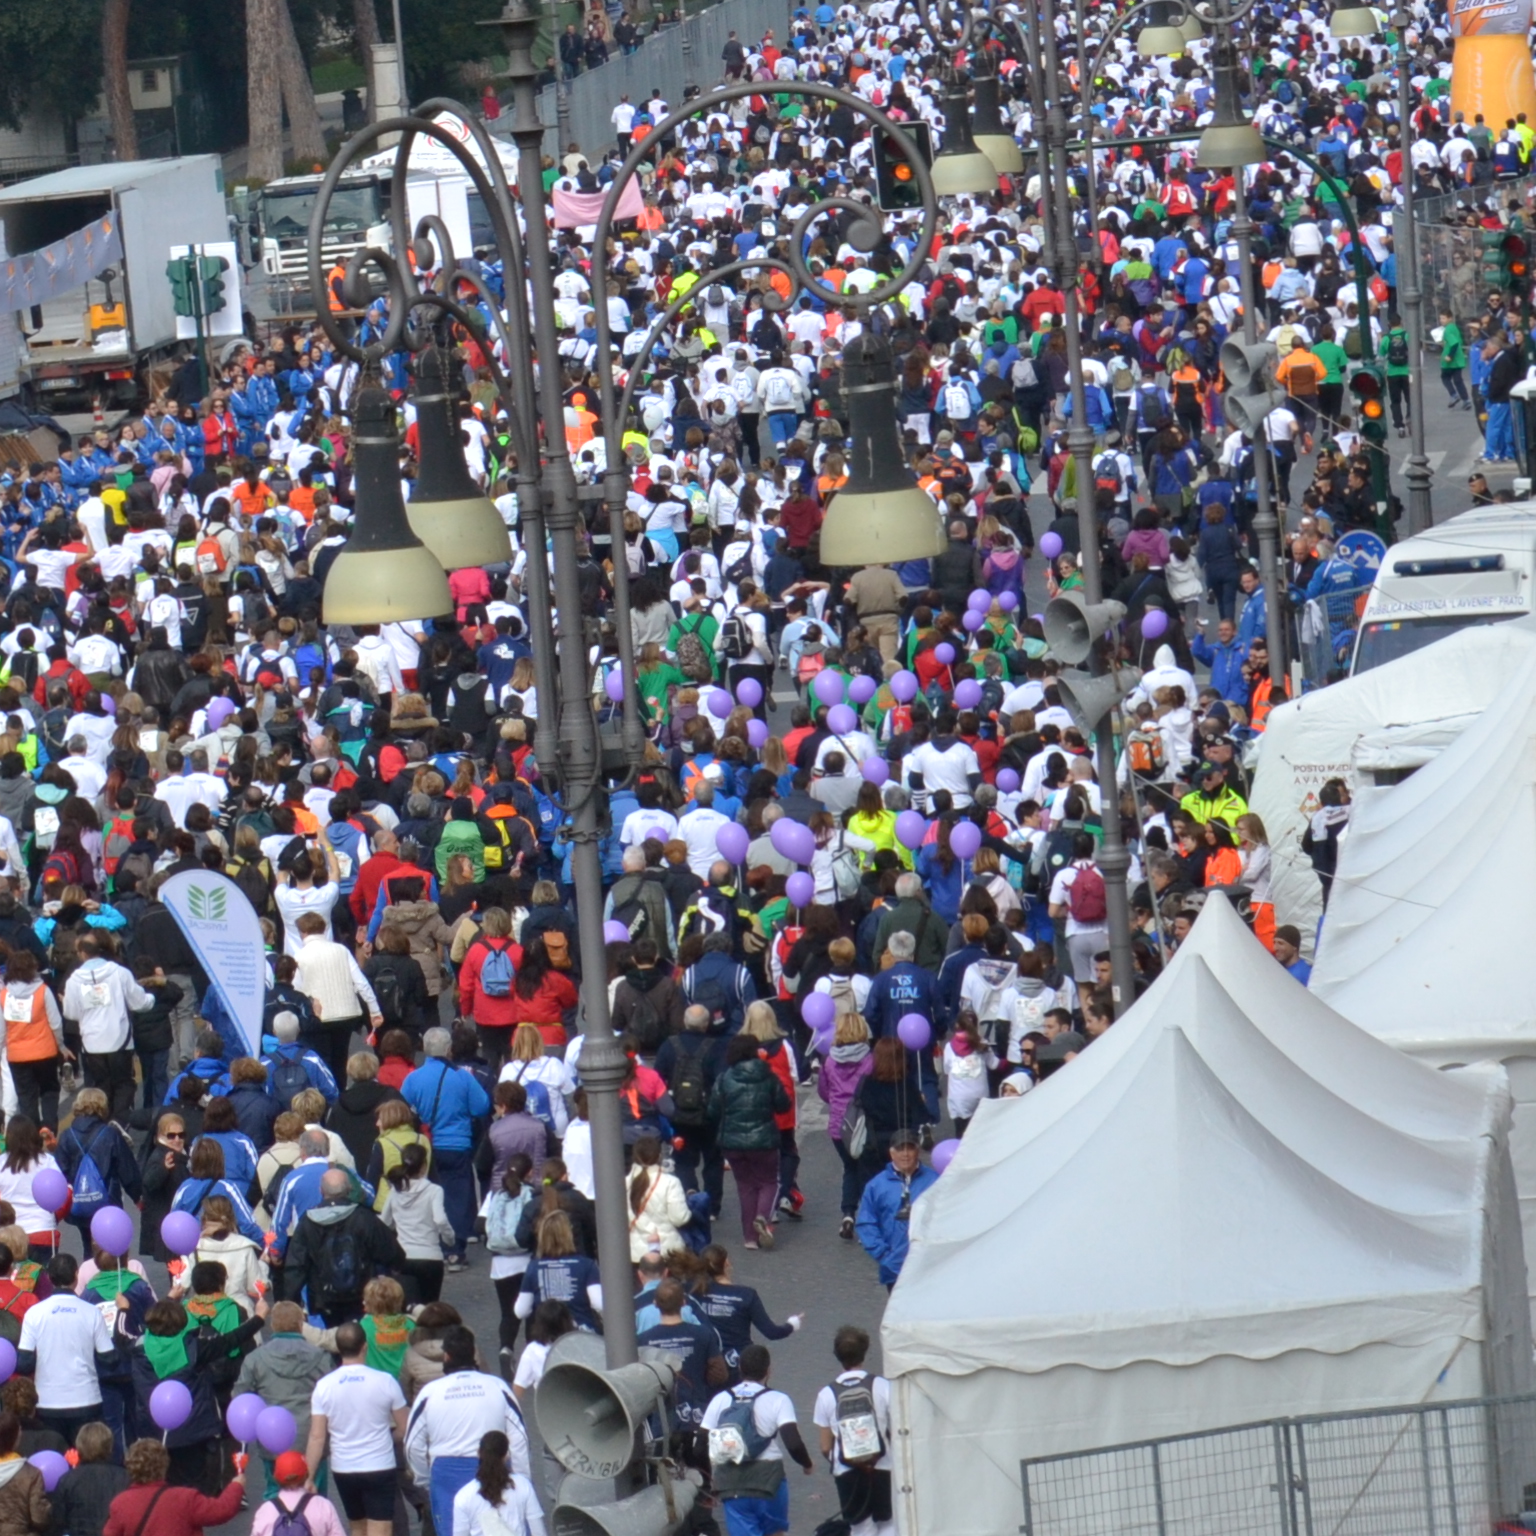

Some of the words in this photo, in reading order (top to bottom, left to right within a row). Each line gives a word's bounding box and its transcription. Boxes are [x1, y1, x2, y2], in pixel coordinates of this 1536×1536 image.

[1368, 603, 1403, 616] PUBBLICA
[1499, 596, 1524, 606] PRATO
[1293, 765, 1326, 773] POSTO
